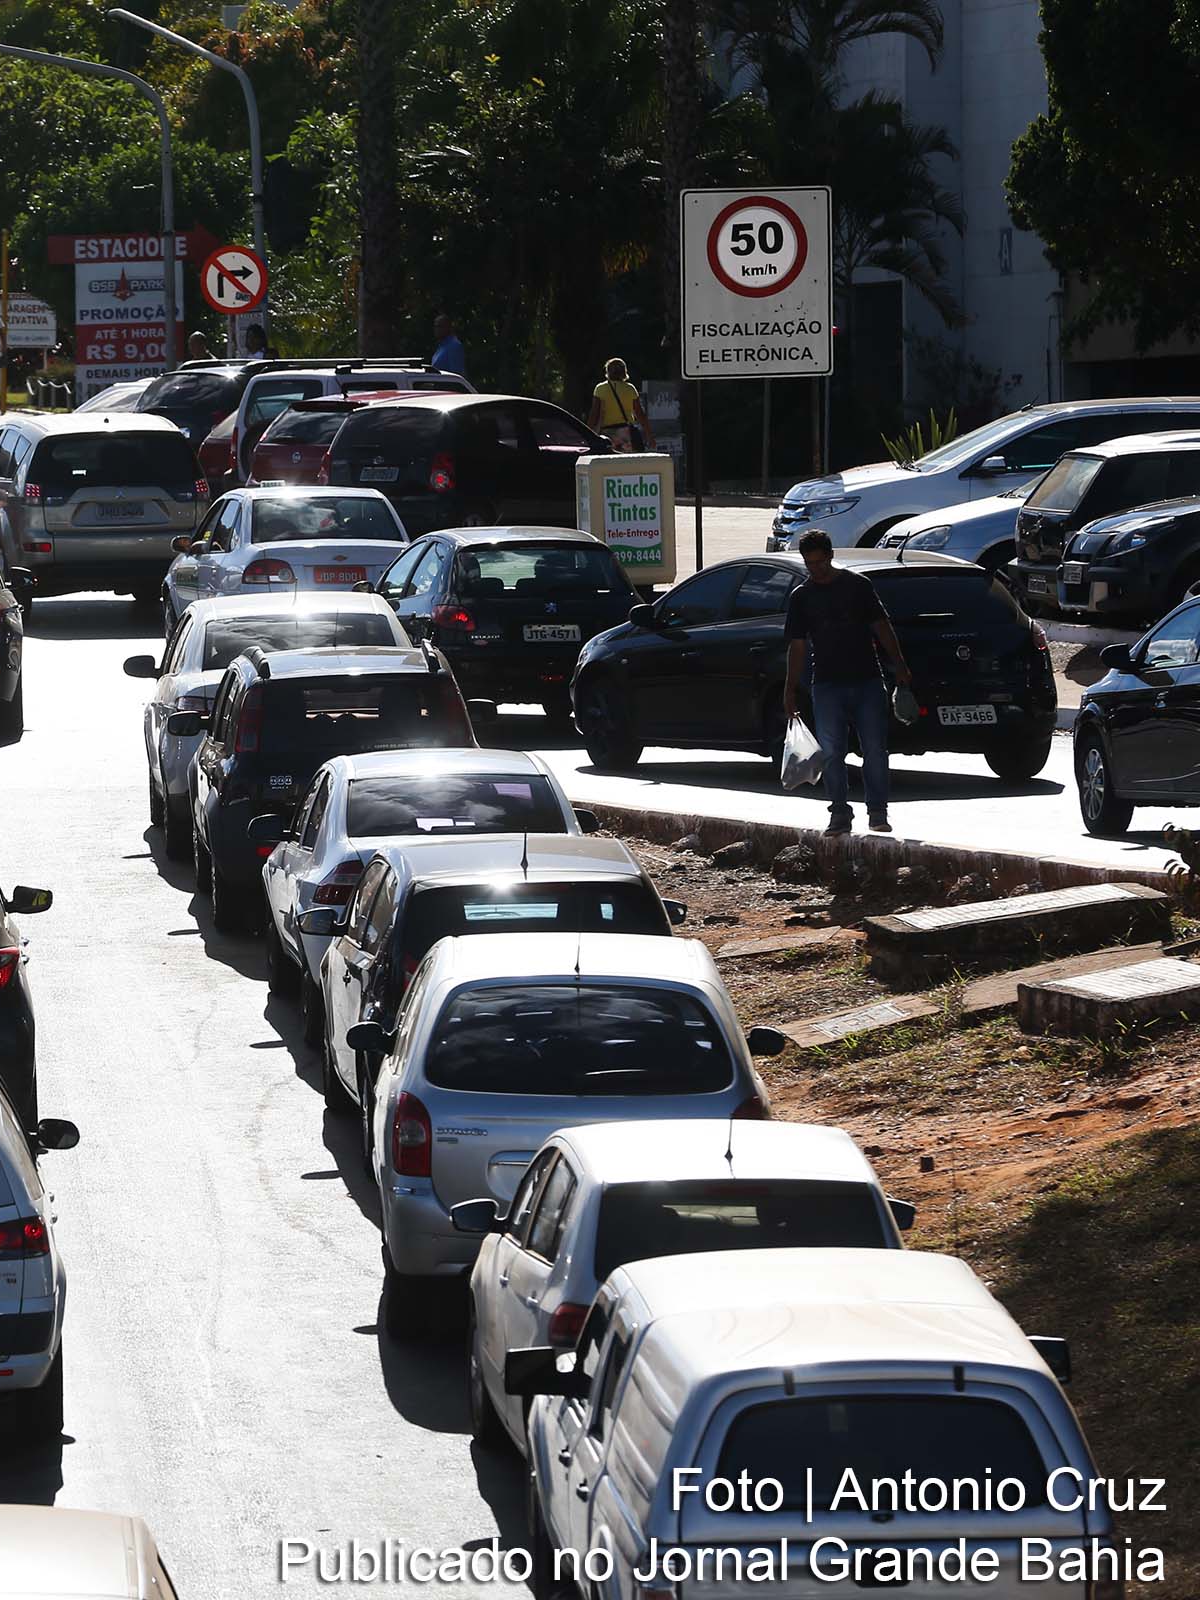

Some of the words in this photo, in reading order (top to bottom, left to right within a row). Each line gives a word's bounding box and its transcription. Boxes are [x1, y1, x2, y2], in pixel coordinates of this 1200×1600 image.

[74, 236, 187, 259] ESTACIOE
[730, 221, 783, 256] 50
[741, 263, 777, 276] km/h
[95, 328, 118, 340] ATÉ
[121, 329, 128, 339] 1
[691, 318, 822, 338] FISCALIZAÇÃO
[699, 344, 813, 363] ELETRÔNICA
[86, 369, 131, 379] DEMAIS
[606, 476, 658, 498] Riacho
[608, 502, 657, 522] Tintas
[607, 528, 659, 539] Tele-Entrega
